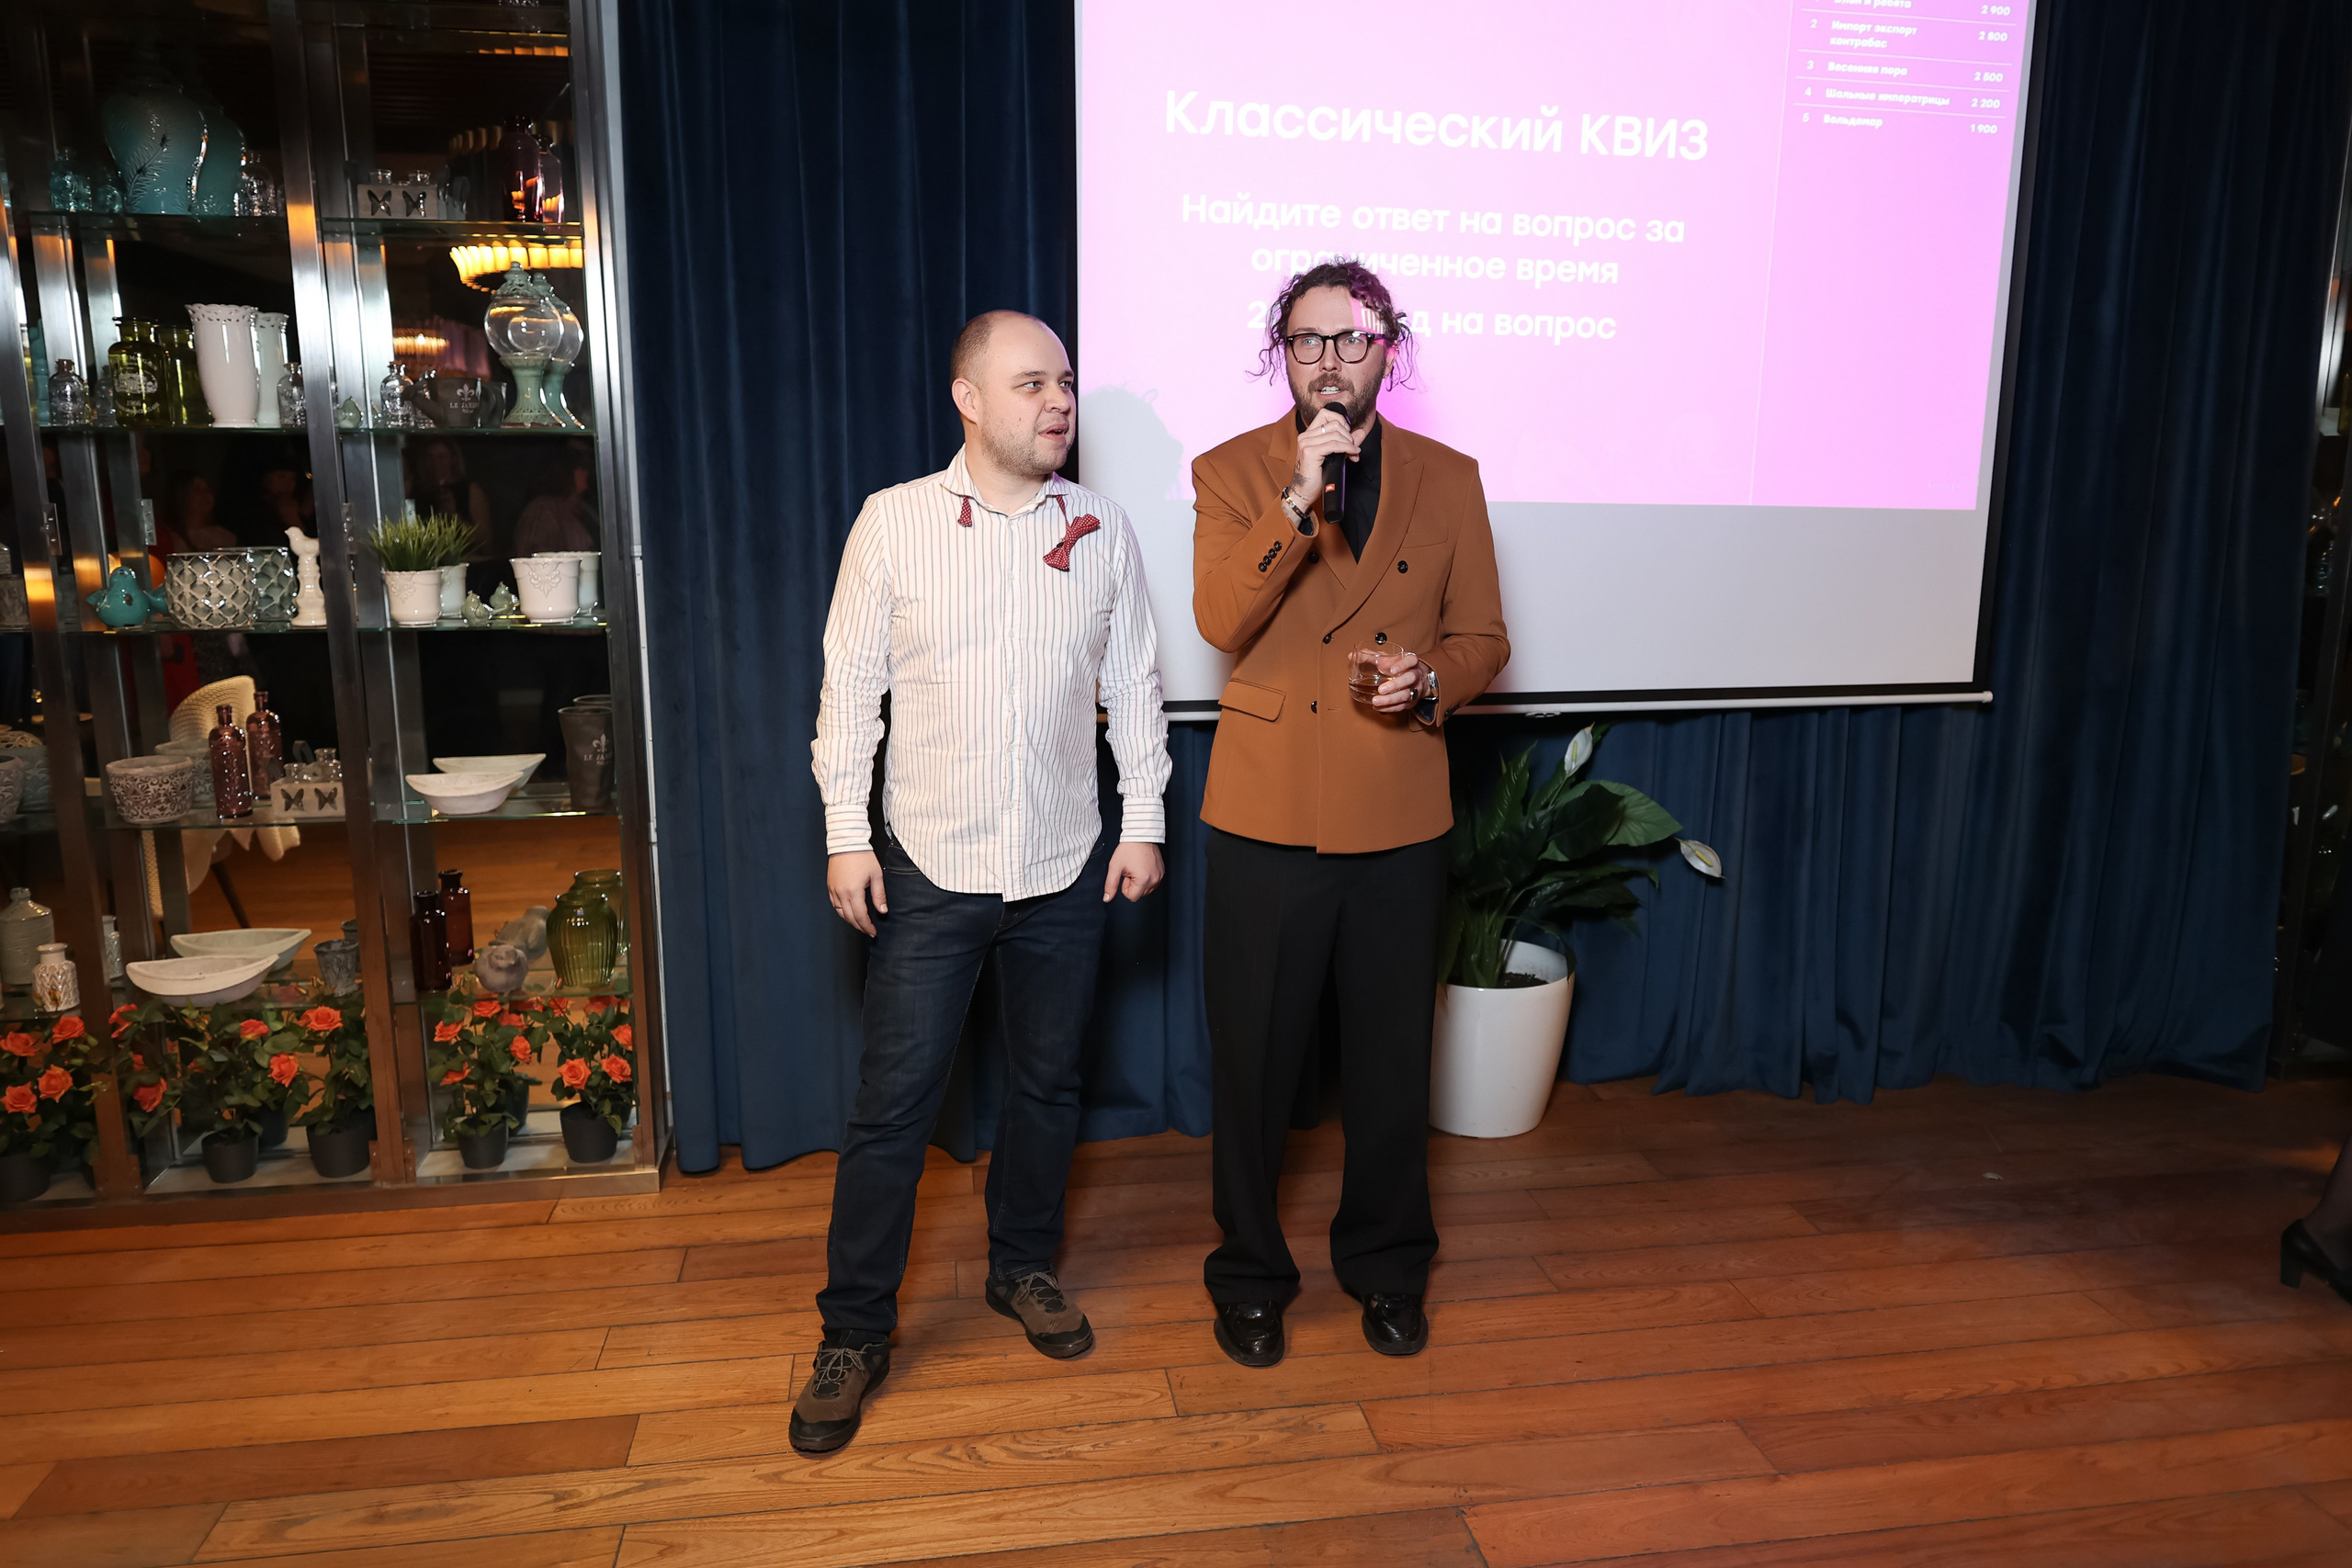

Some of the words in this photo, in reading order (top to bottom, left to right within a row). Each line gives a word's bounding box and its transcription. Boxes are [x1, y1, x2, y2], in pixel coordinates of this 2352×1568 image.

[1981, 5, 1989, 15] 2
[1990, 5, 2011, 16] 900
[1810, 18, 1818, 28] 2
[1831, 20, 1872, 35] Импорт
[1873, 24, 1918, 37] экспорт
[1978, 30, 1986, 40] 2
[1829, 37, 1888, 49] контрабас
[1806, 60, 1815, 70] 3
[1827, 61, 1880, 74] Весенняя
[1880, 66, 1908, 78] пора
[1973, 71, 1982, 82] 2
[1804, 86, 1812, 96] 4
[1825, 87, 1877, 101] Шальные
[1878, 93, 1951, 107] императрицы
[1971, 97, 1979, 107] 2
[1980, 98, 2001, 109] 200
[1166, 90, 1563, 152] Классический
[1579, 113, 1708, 161] КВИЗ
[1802, 112, 1810, 123] 5
[1823, 113, 1883, 130] Вольдемар
[1970, 123, 1976, 133] 1
[1977, 124, 1998, 134] 900
[1182, 191, 1342, 231] Найдите
[1351, 206, 1451, 232] ответ
[1459, 210, 1502, 235] на
[1512, 213, 1636, 247] вопрос
[1645, 220, 1685, 243] за
[1250, 248, 1508, 281] ограиченное
[1516, 258, 1619, 290] время
[1442, 311, 1484, 335] на
[1494, 313, 1617, 346] вопрос
